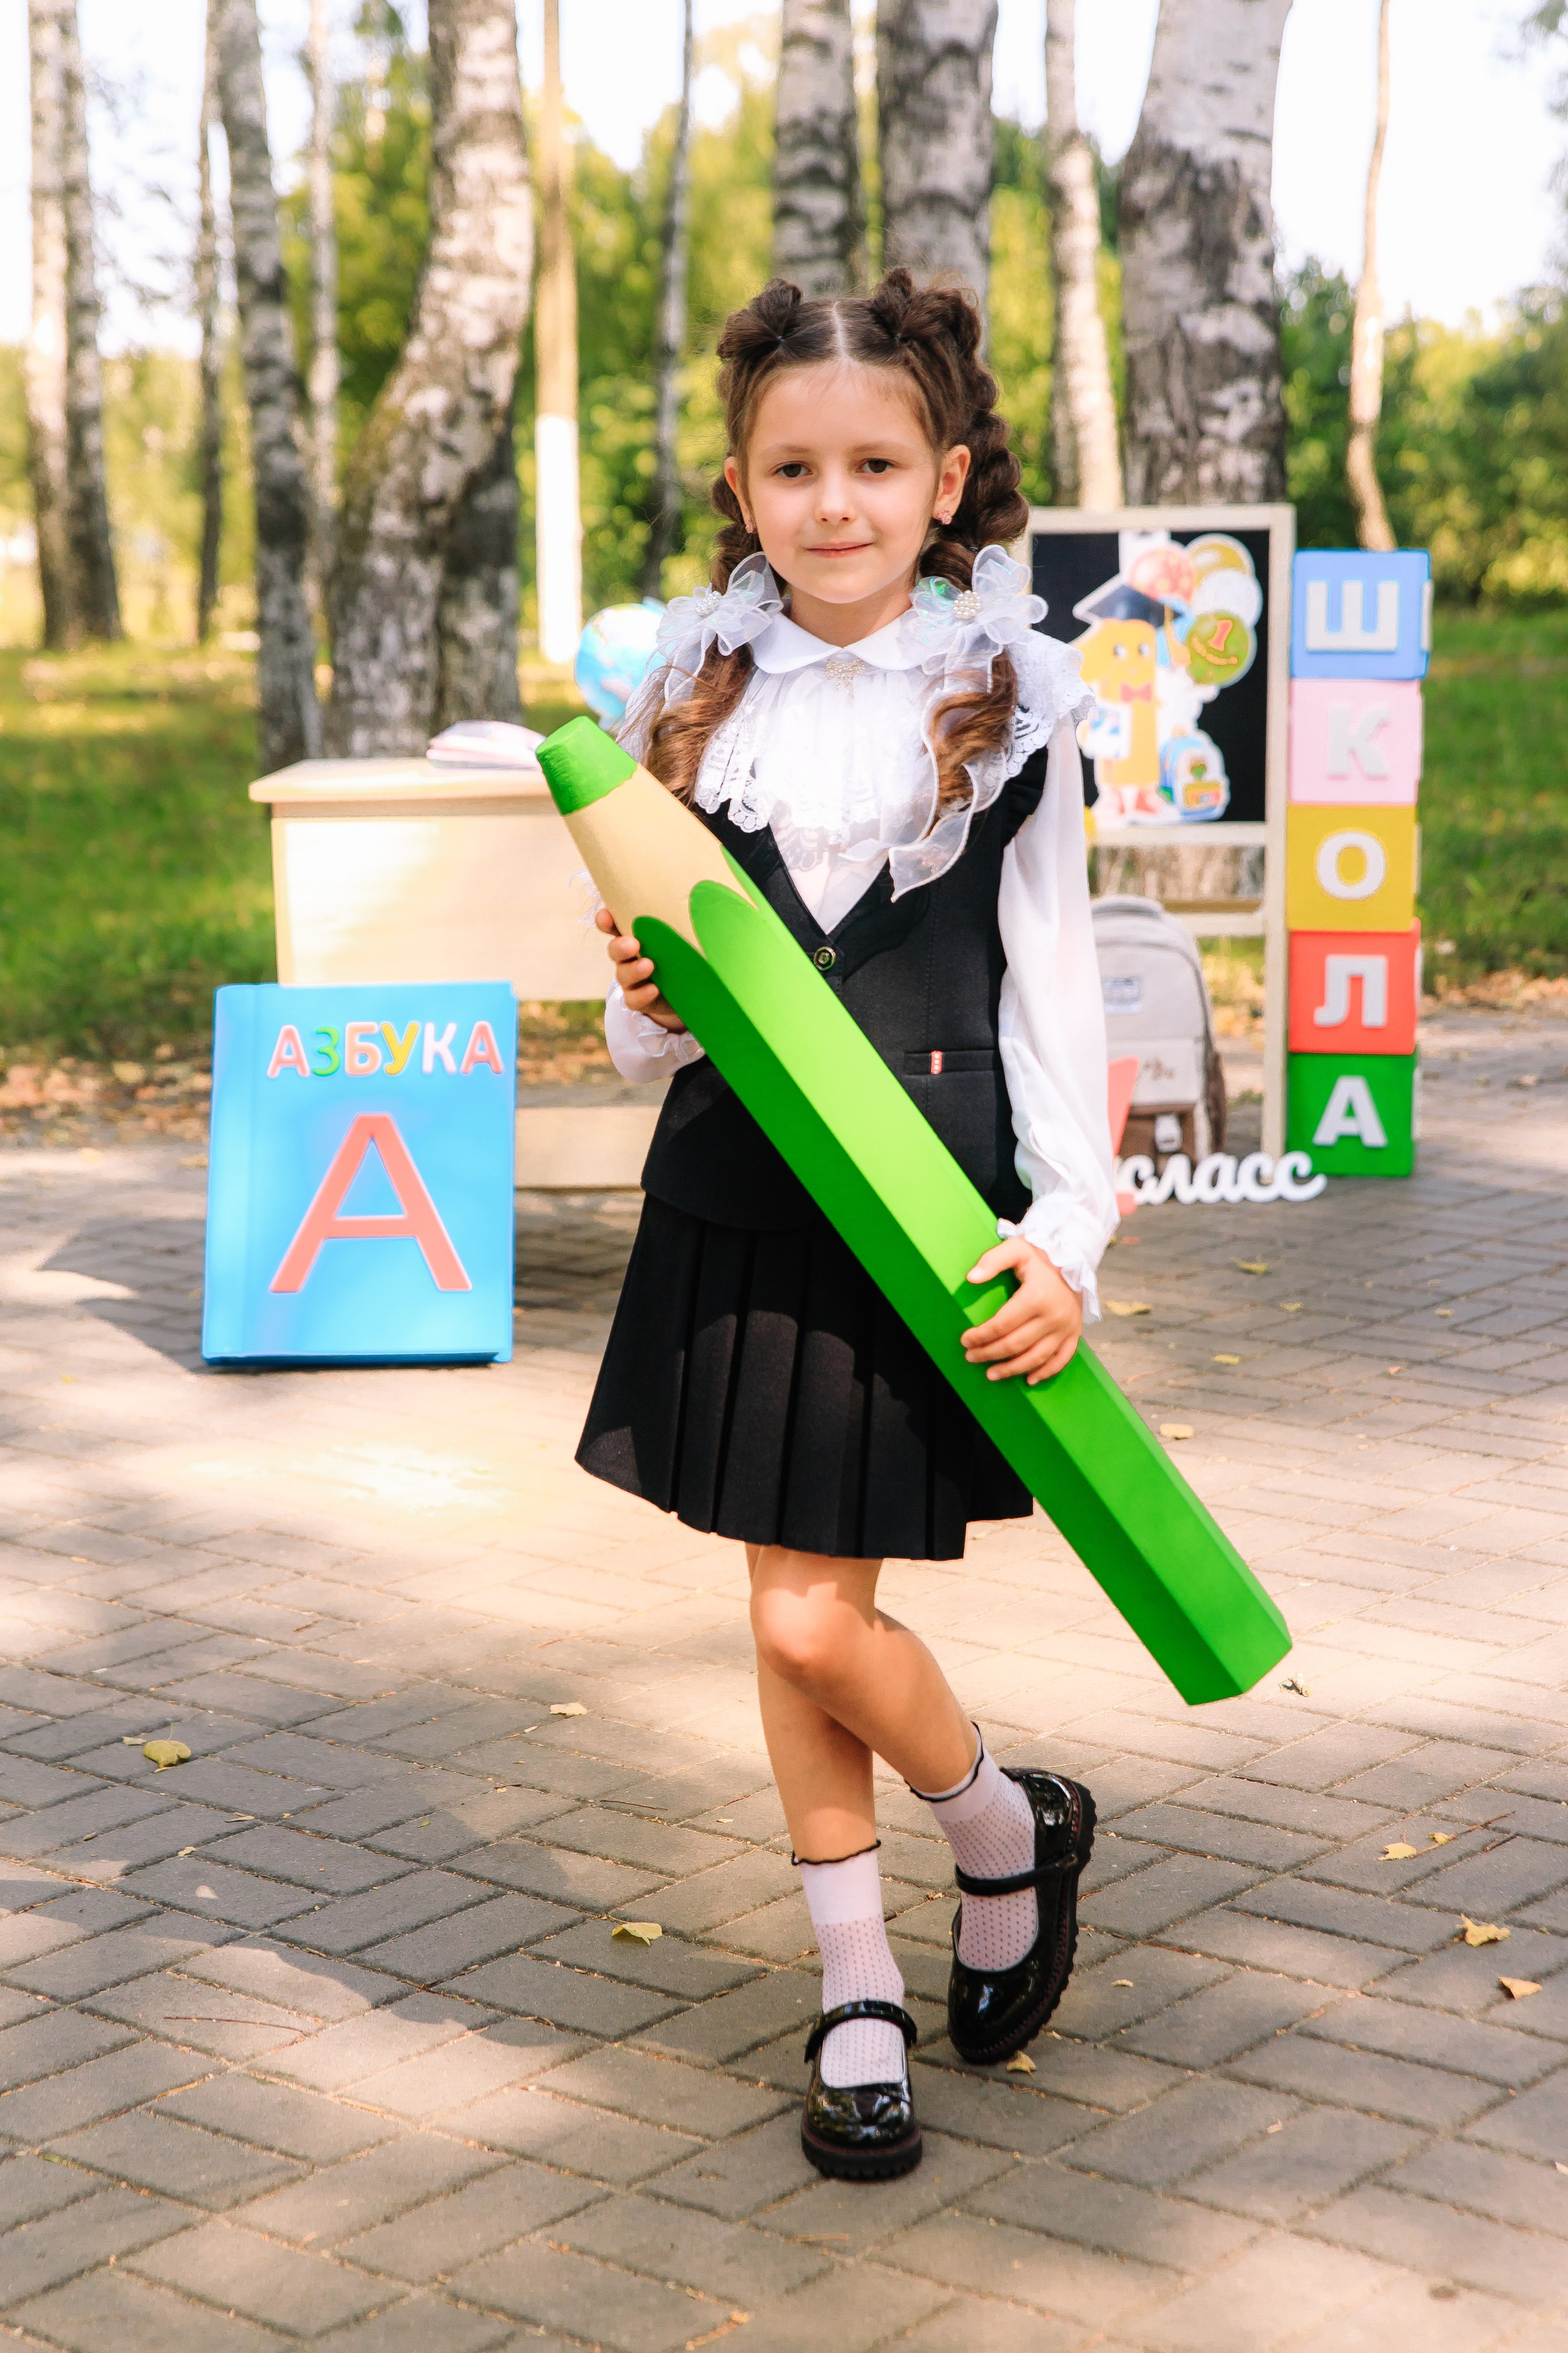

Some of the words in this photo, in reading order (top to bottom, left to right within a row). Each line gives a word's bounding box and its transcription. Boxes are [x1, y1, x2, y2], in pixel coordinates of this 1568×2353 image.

[1305, 579, 1400, 1146] ШКОЛА
[268, 1021, 503, 1077] АЗБУКА
[270, 1113, 472, 1292] А
